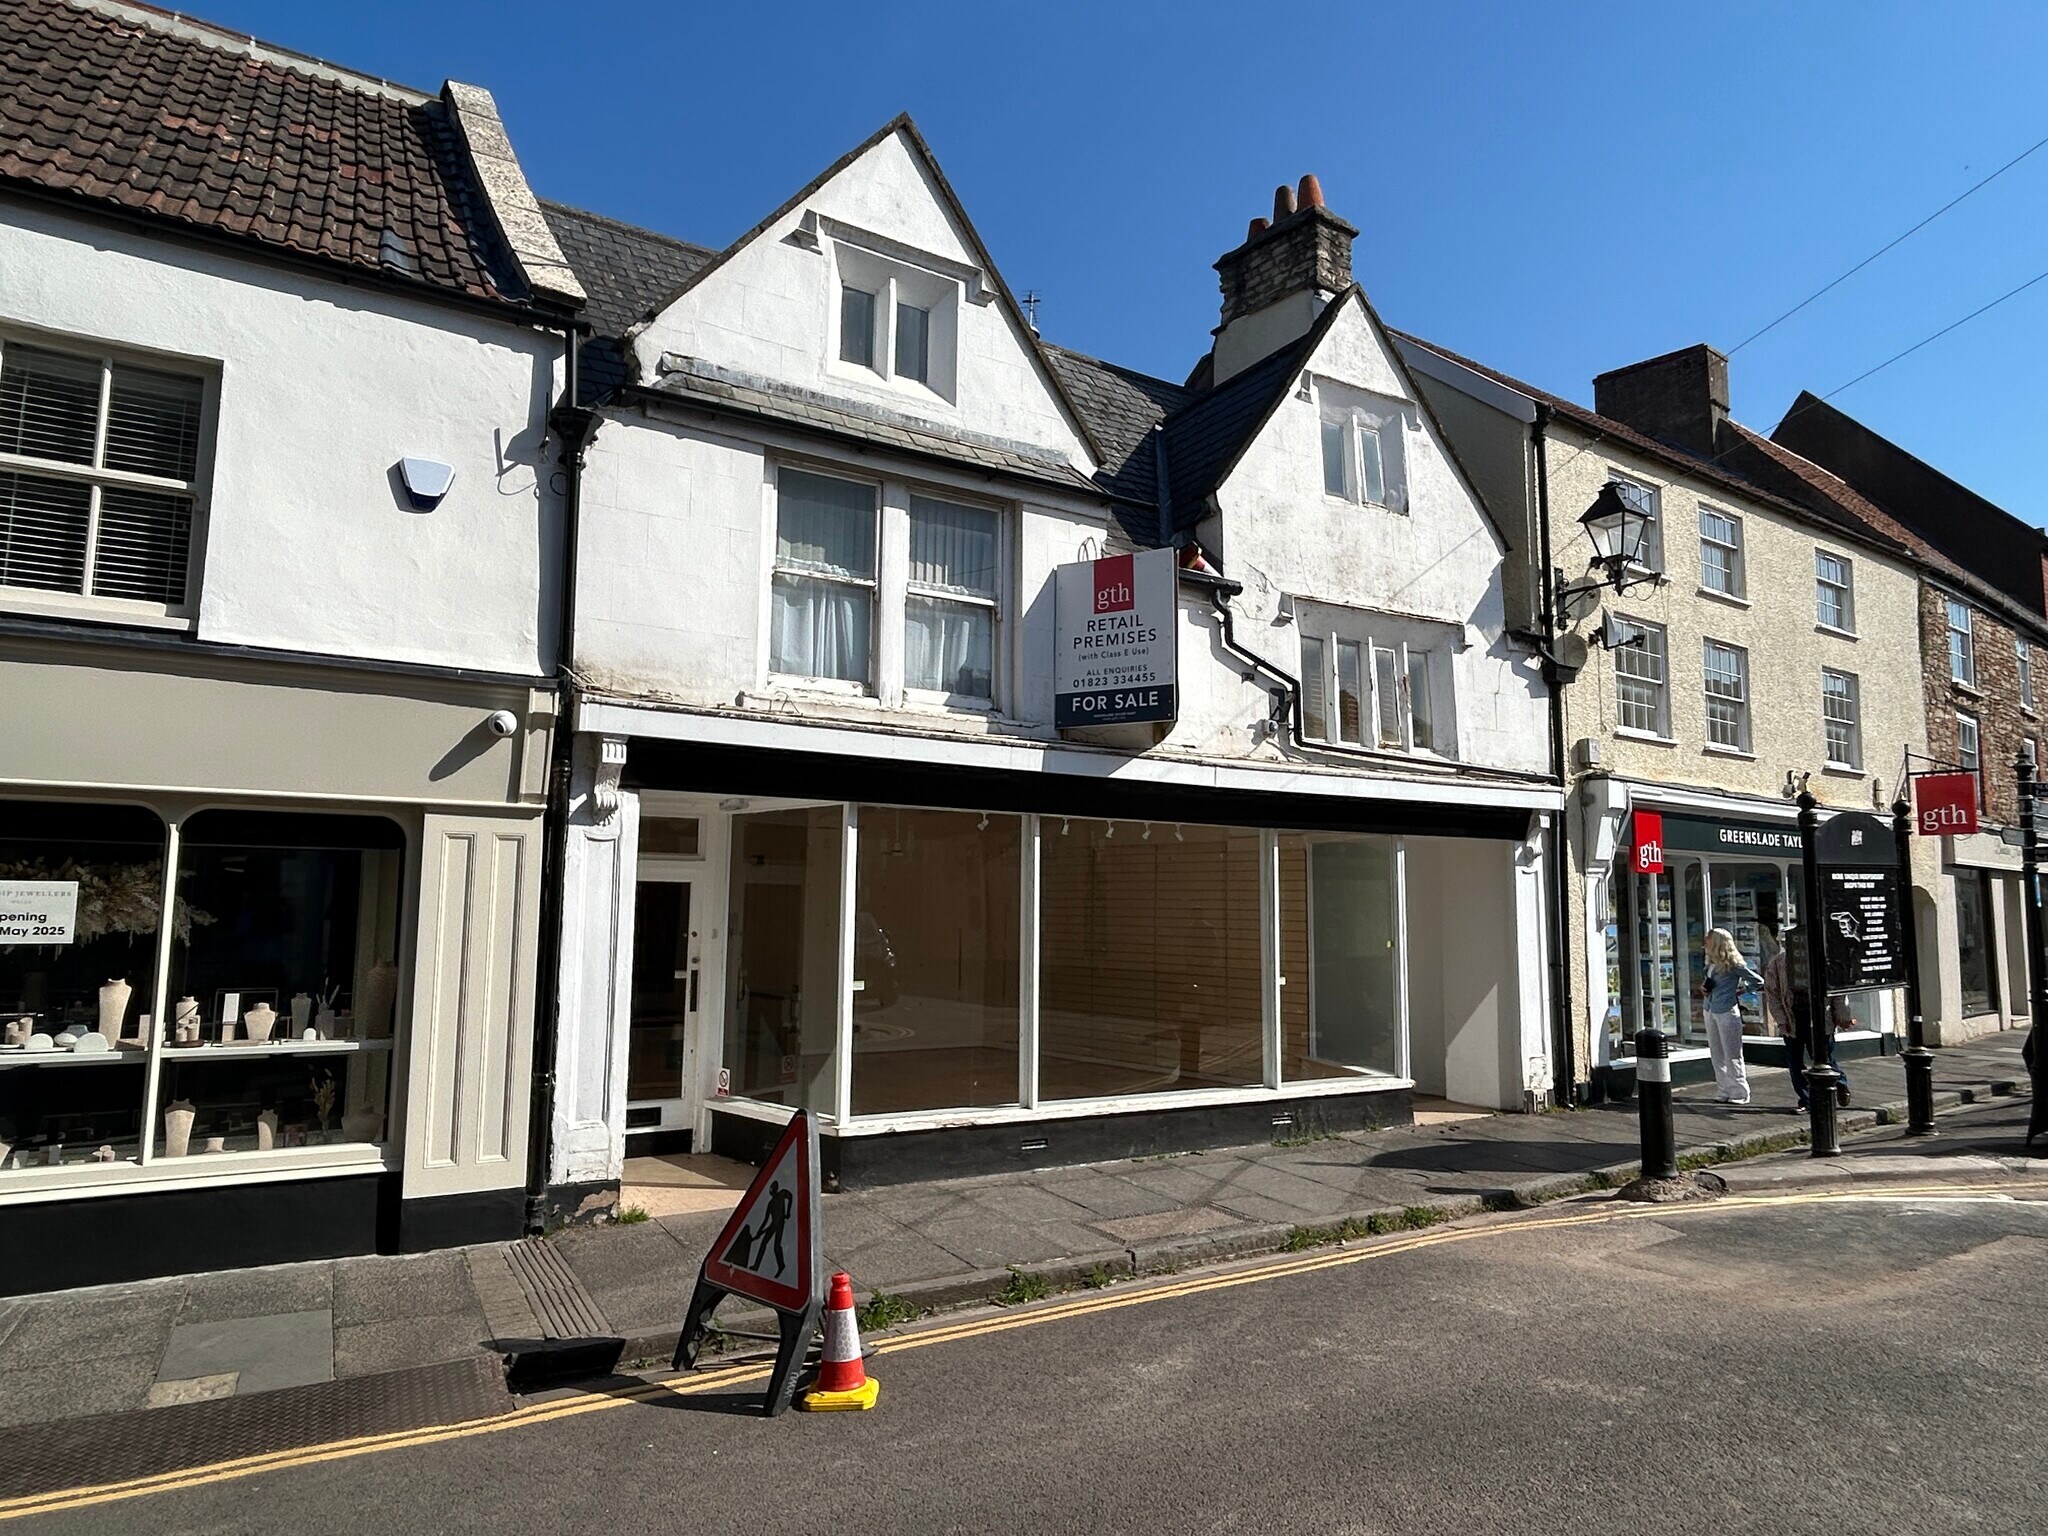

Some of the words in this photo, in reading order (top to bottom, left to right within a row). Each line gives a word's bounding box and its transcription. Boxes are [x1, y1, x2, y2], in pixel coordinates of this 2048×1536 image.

[1097, 583, 1130, 609] gth
[1087, 614, 1143, 632] RETAIL
[1073, 628, 1157, 649] PREMISES
[1078, 650, 1099, 662] (with
[1101, 649, 1121, 659] Class
[1124, 648, 1129, 656] E
[1132, 647, 1149, 656] Use)
[1073, 676, 1108, 688] 01823
[1113, 672, 1156, 685] 334455
[1087, 669, 1101, 677] ALL
[1104, 664, 1148, 675] ENQUIRIES
[1072, 695, 1107, 712] FOR
[1114, 691, 1159, 709] SALE
[1923, 803, 1968, 831] gth
[1719, 828, 1781, 847] GREENSLADE
[1640, 840, 1662, 868] gth
[0, 926, 28, 937] May
[32, 926, 65, 936] 2025
